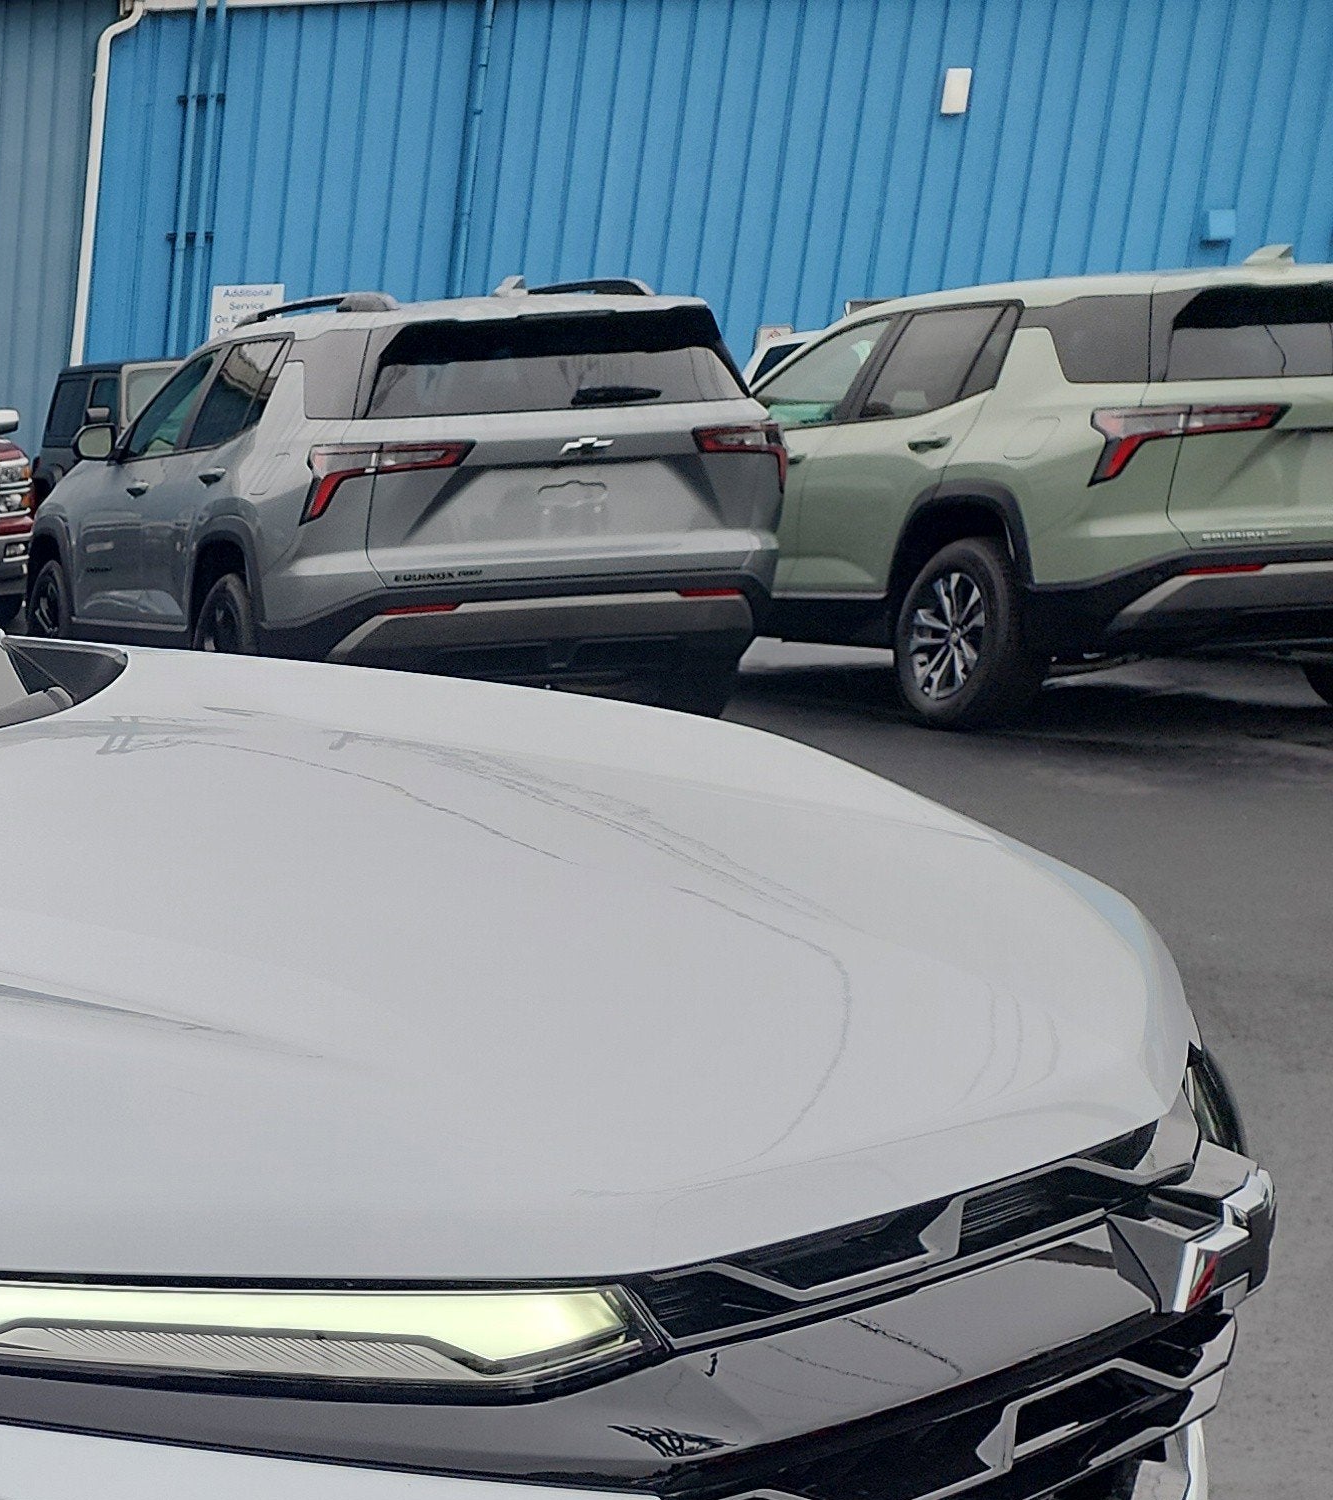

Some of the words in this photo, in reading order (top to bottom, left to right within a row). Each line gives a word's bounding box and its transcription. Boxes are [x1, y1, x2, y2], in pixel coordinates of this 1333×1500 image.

[222, 287, 273, 298] Additional
[228, 301, 265, 311] Service
[393, 571, 456, 582] EQUINOX
